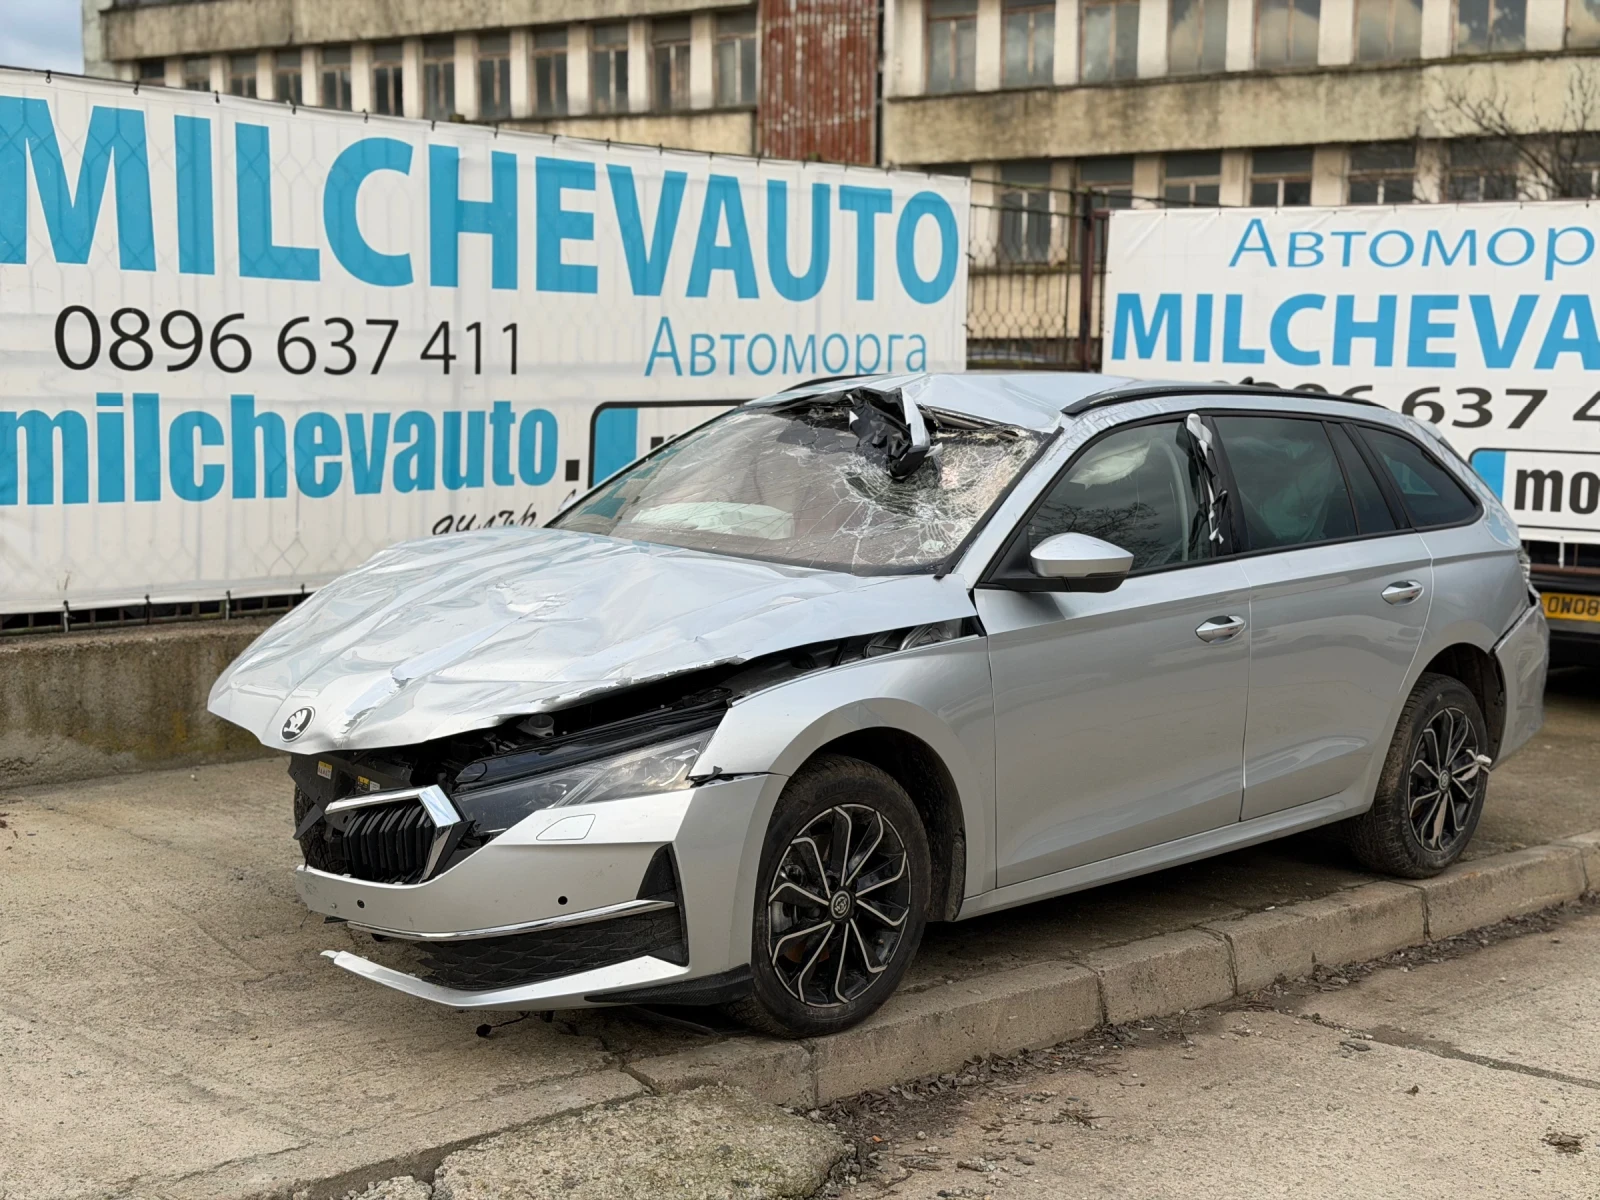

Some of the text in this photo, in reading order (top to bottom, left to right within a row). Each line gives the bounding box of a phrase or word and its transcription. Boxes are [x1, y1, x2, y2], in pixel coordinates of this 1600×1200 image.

[0, 95, 959, 304] MILCHEVAUTO
[1228, 218, 1596, 281] Автомор
[54, 305, 519, 375] 0896 637 411
[644, 316, 927, 376] Автоморга
[1111, 293, 1600, 371] MILCHEVA
[1401, 386, 1548, 430] 637
[1514, 468, 1600, 515] mo
